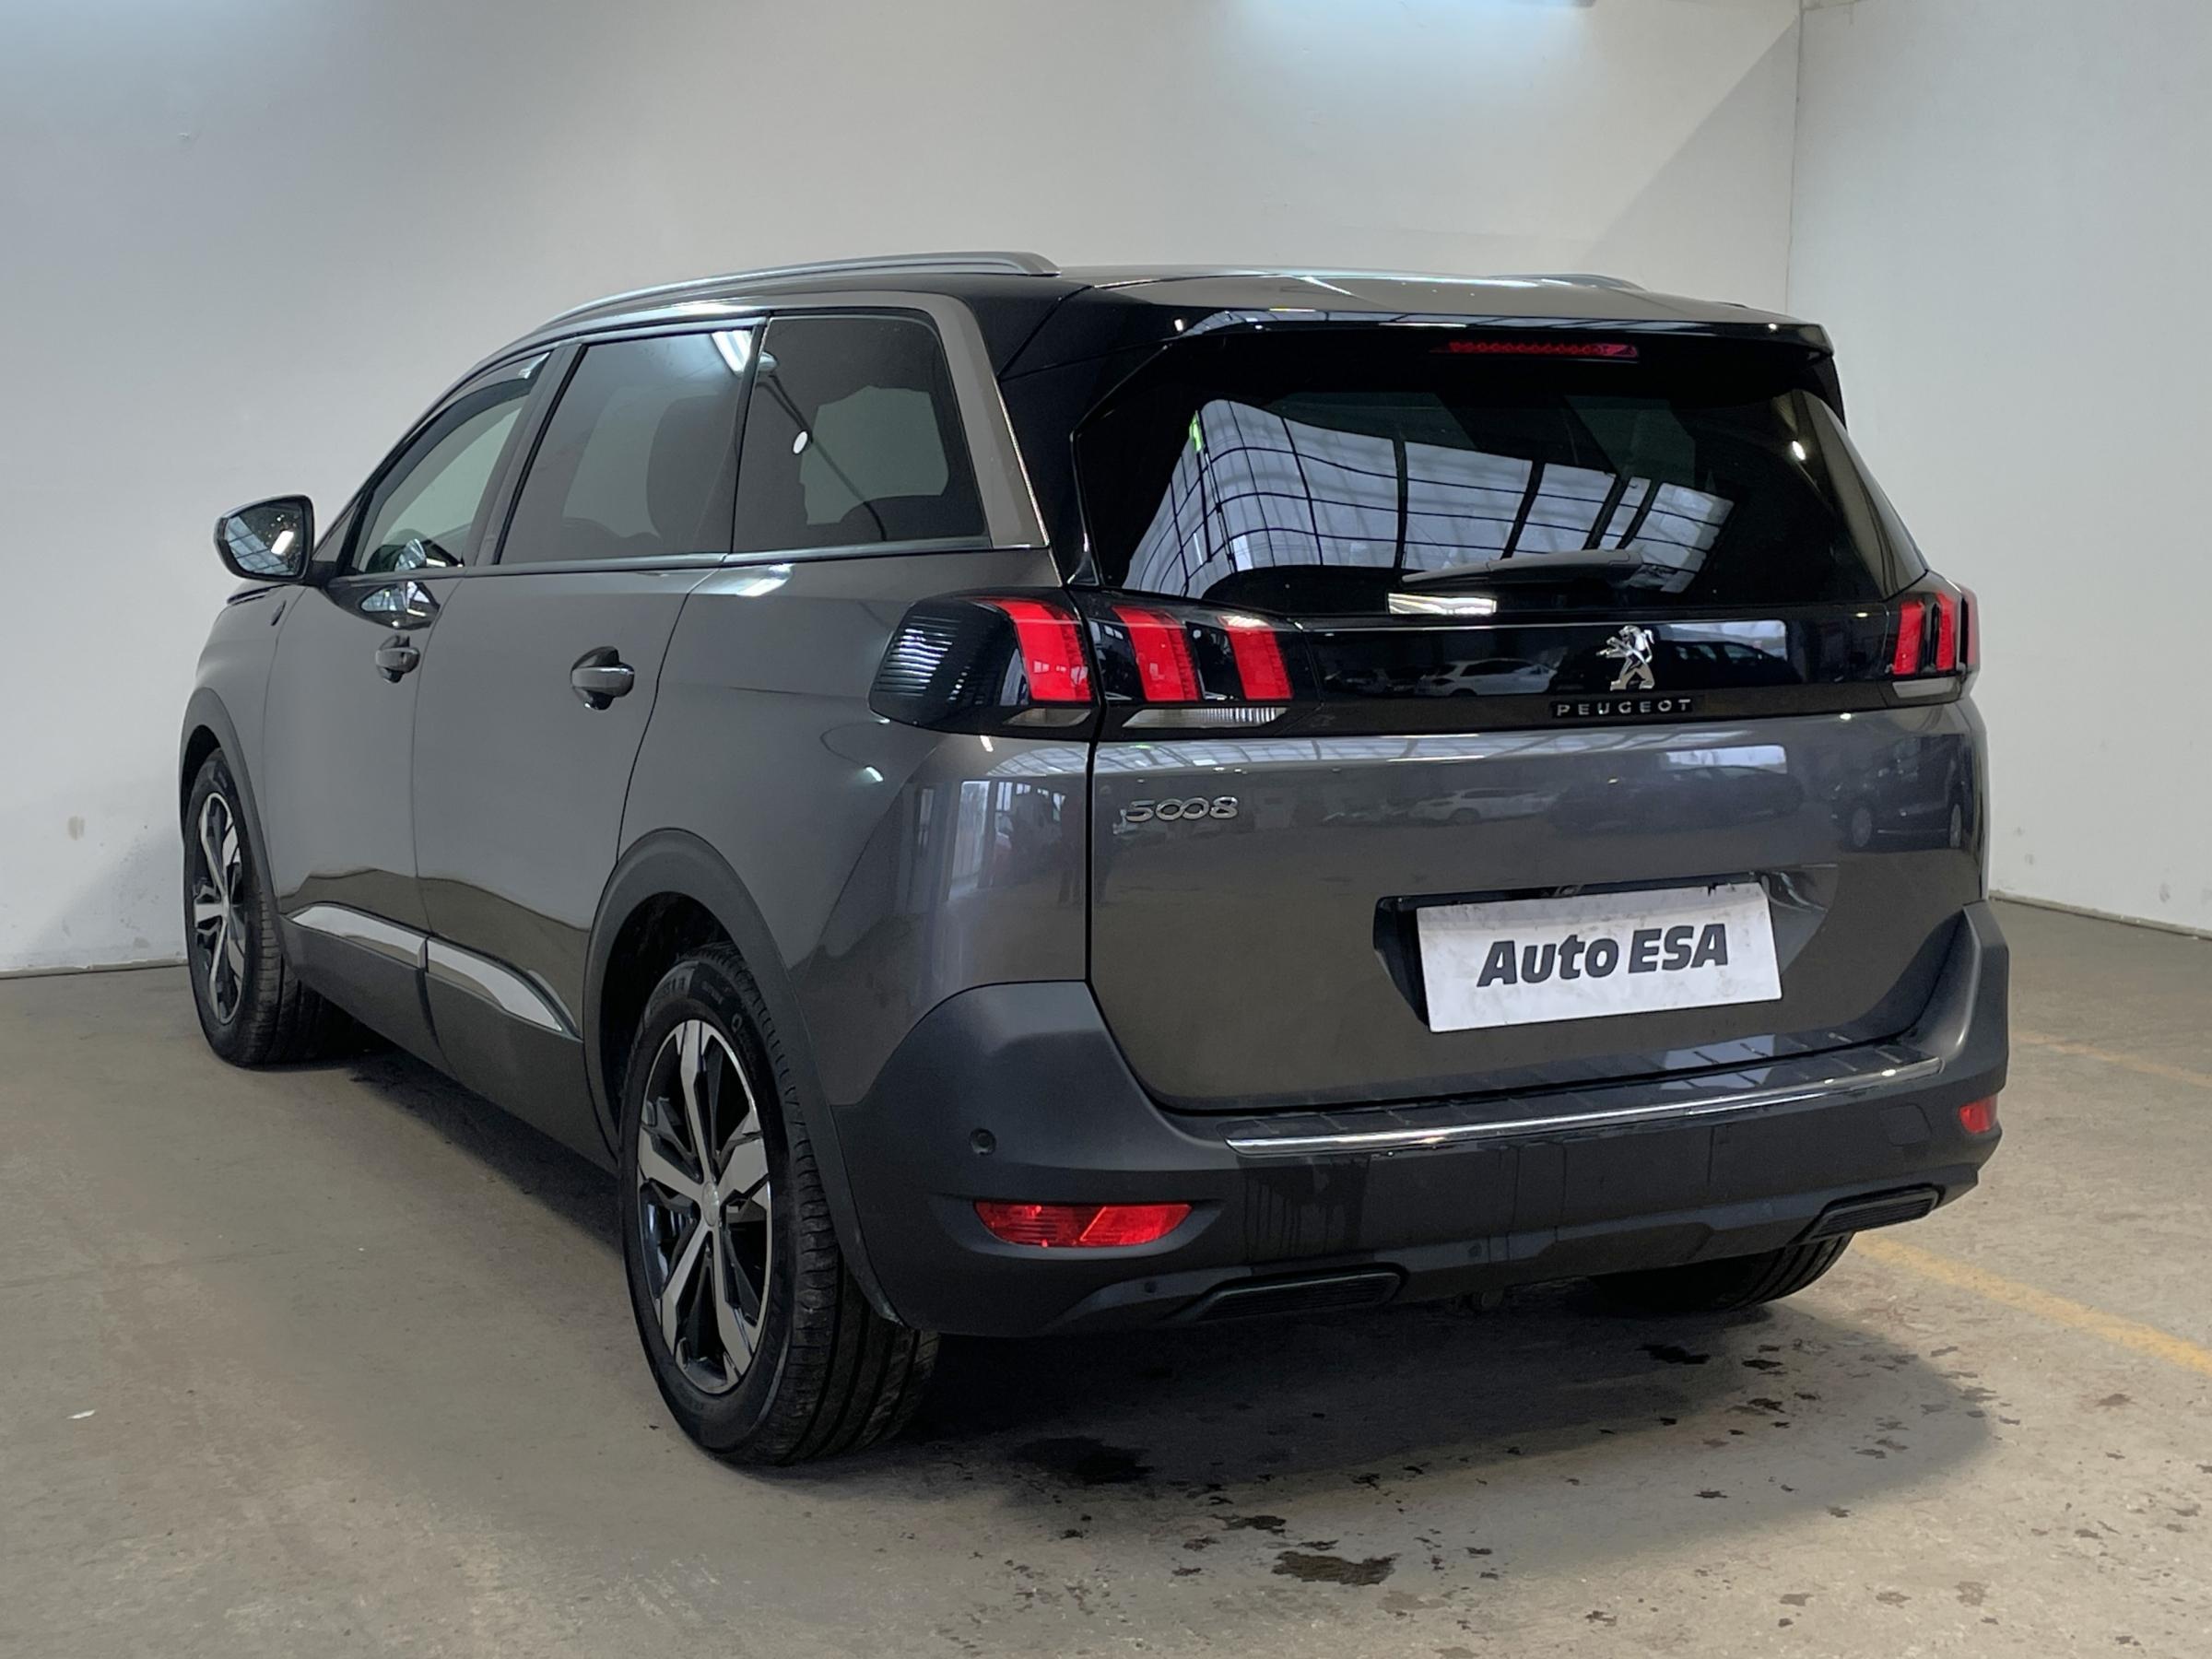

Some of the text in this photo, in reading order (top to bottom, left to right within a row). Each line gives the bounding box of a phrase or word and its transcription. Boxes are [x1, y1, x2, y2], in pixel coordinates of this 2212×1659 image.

[1557, 699, 1691, 716] PEUGEOT
[1125, 795, 1238, 821] 5008
[1477, 923, 1728, 987] Auto ESA
